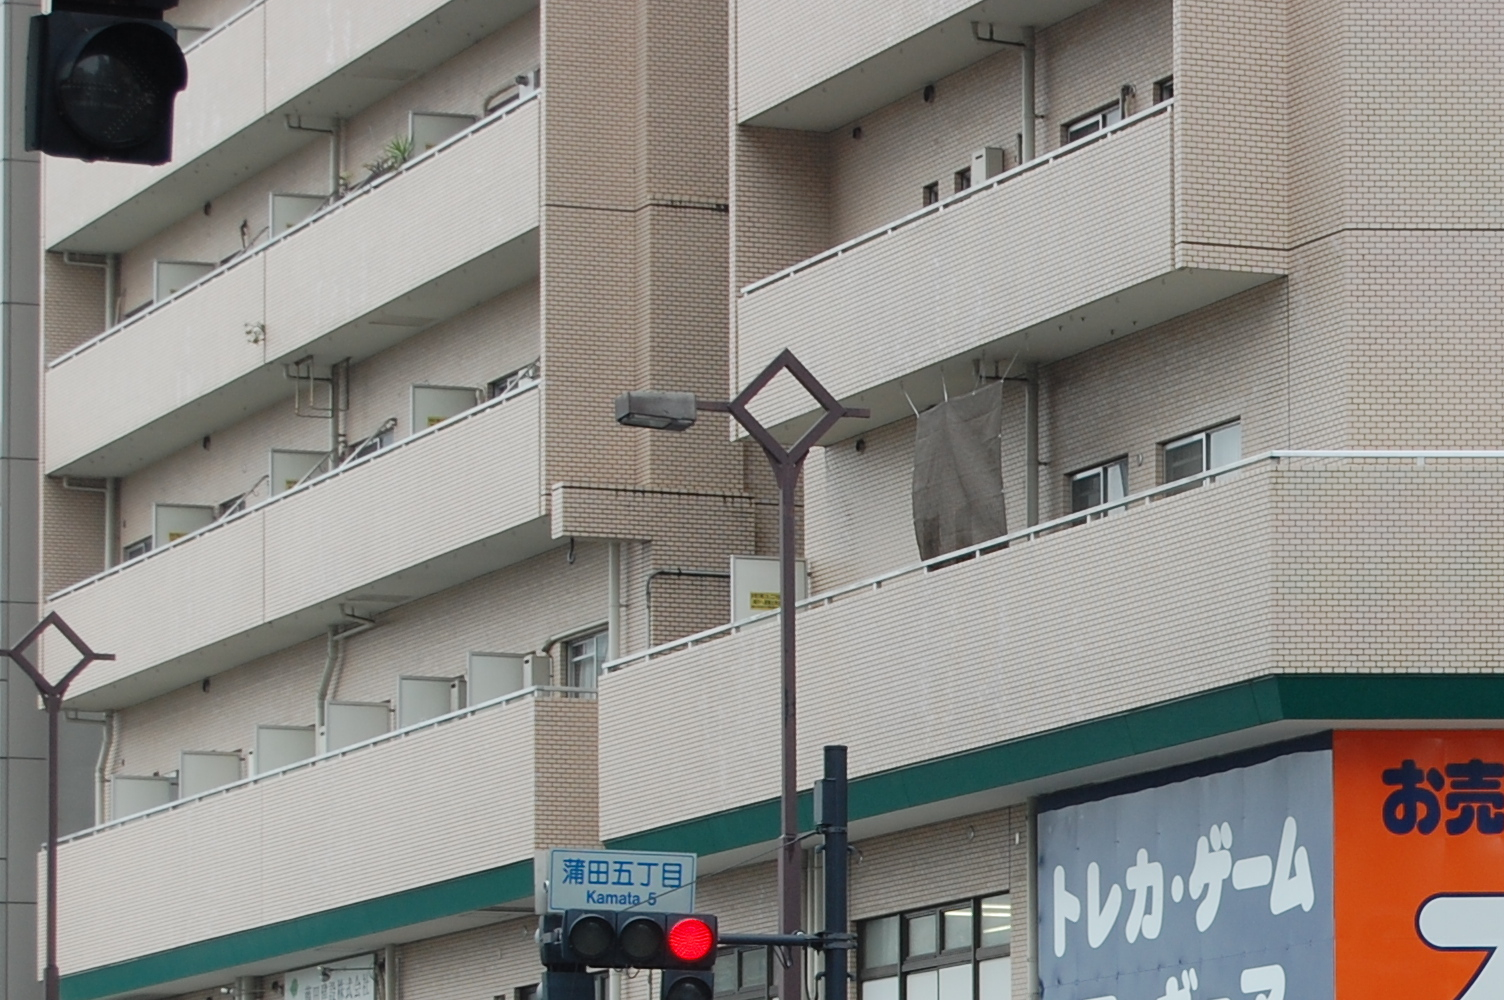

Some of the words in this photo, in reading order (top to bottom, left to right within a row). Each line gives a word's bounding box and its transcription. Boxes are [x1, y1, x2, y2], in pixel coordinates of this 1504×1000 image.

[562, 858, 682, 888] 蒲田五丁目
[1053, 815, 1315, 958] トレカ・ゲーム
[586, 889, 641, 906] Kamata
[647, 891, 658, 906] 5
